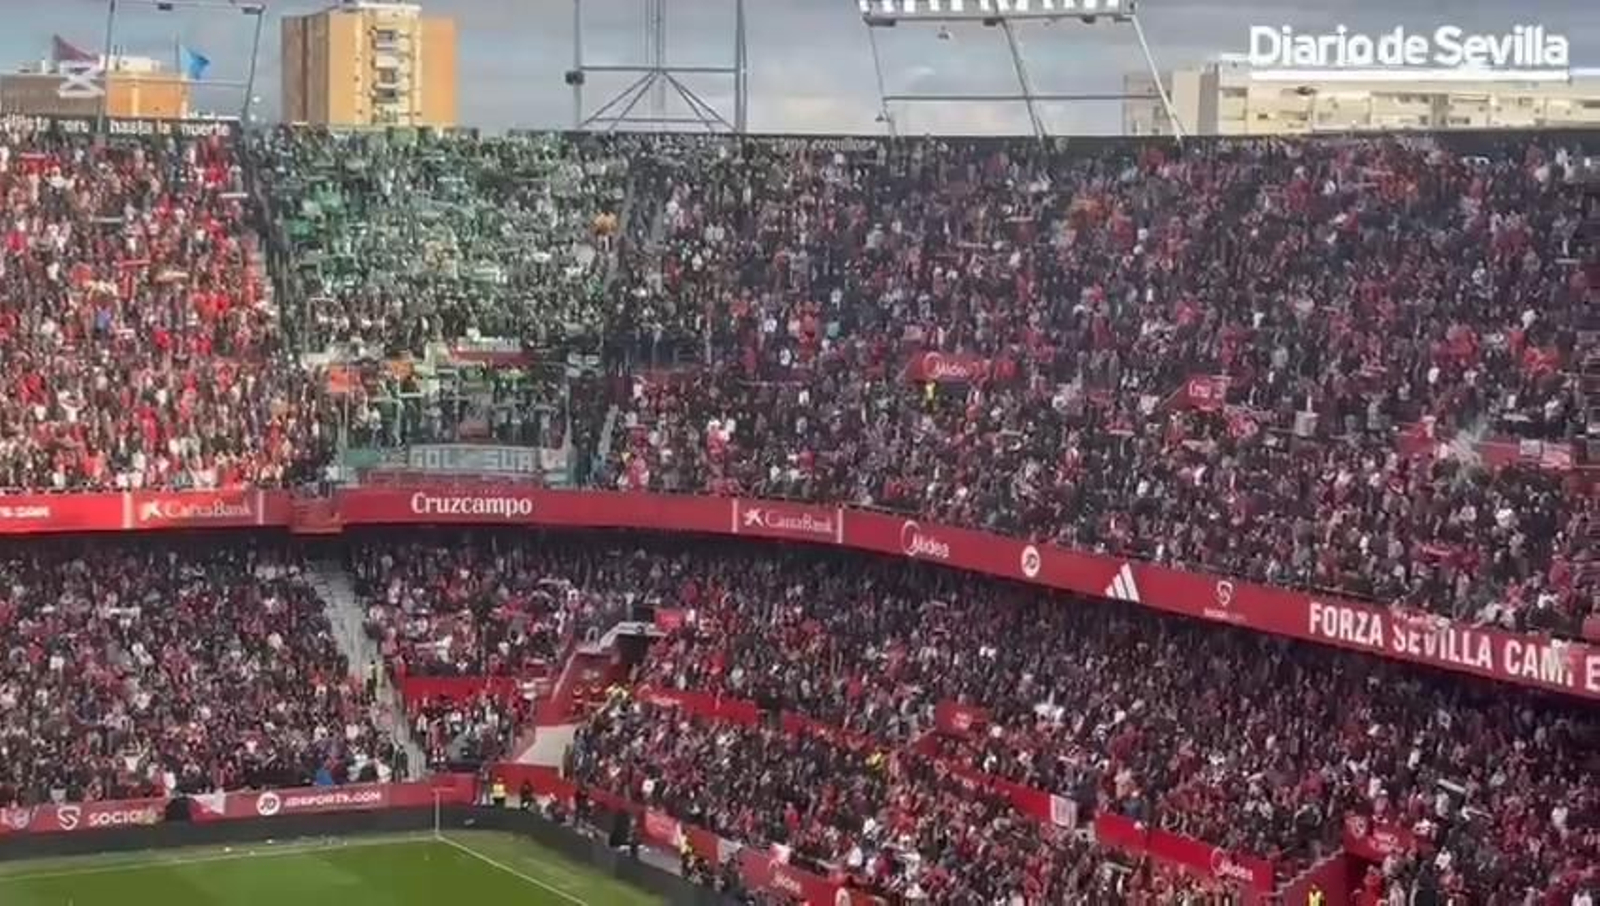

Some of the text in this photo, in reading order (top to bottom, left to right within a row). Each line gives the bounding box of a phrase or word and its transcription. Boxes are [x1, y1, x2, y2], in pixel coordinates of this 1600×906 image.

[411, 492, 533, 518] Cruzcampo
[1309, 602, 1384, 647] FORZA
[1393, 618, 1494, 671] SEVILLA
